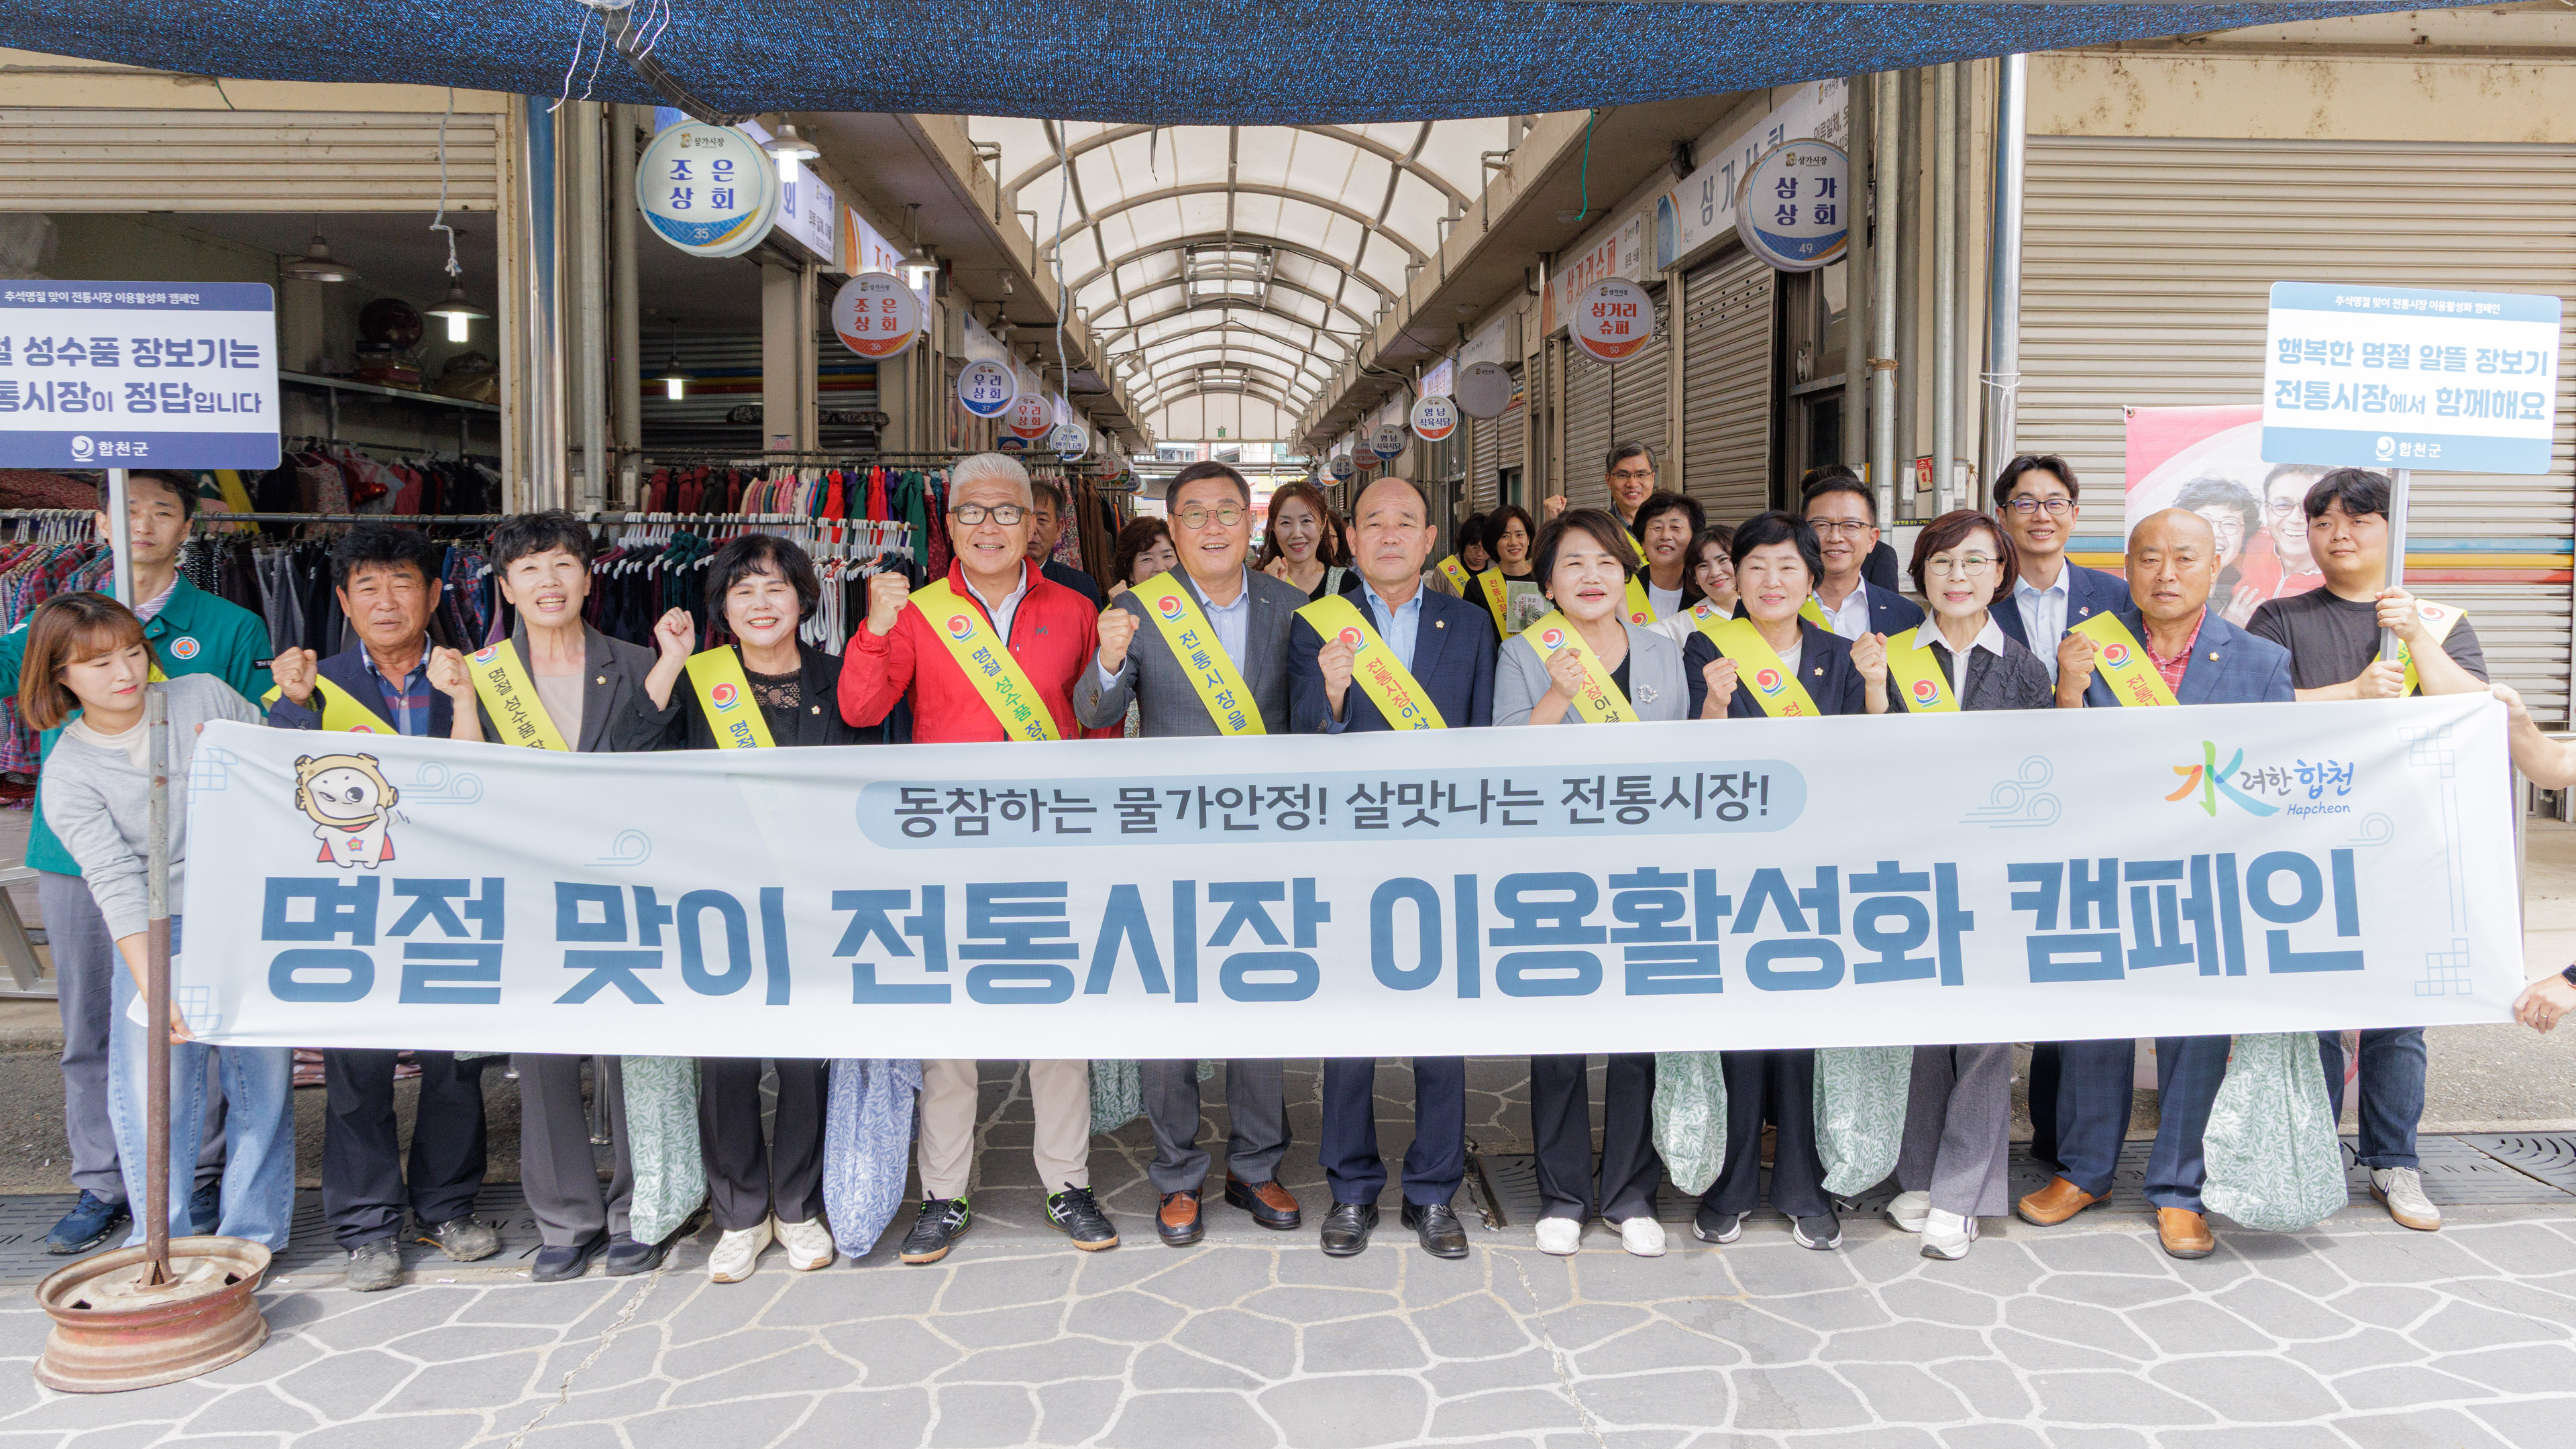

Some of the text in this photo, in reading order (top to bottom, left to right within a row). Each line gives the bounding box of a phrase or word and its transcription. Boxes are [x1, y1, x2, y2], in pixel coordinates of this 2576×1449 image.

[694, 137, 724, 146] 삼가시장
[1798, 156, 1827, 165] 삼가시장
[669, 159, 735, 182] 조은
[1774, 176, 1837, 199] 삼가
[669, 187, 734, 209] 상회
[1774, 204, 1837, 225] 상회
[694, 227, 709, 239] 35
[1799, 243, 1813, 254] 49
[5, 291, 200, 305] 추석명절 맞이 전통시장 이용활성화 캠페인
[853, 298, 898, 313] 조은
[2334, 295, 2500, 315] 추석명절 맞이 전통시장 이용활성화 캠페인
[1591, 303, 1638, 318] 삼거리
[854, 316, 898, 331] 상회
[1599, 321, 1630, 335] 슈퍼
[23, 336, 120, 367] 성수품
[131, 337, 260, 369] 장보기는
[871, 343, 881, 351] 36
[2278, 337, 2548, 376] 행복한 명절 알뜰 장보기
[973, 374, 1002, 386] 우리
[125, 382, 262, 413] 정답입니다
[973, 388, 1001, 399] 상회
[2275, 380, 2545, 420] 전통시장에서 함께해요
[1018, 405, 1041, 415] 우리
[1424, 408, 1446, 417] 영남
[1018, 417, 1040, 425] 상회
[1420, 417, 1450, 427] 식육식당
[98, 441, 149, 457] 합천군
[2399, 442, 2442, 458] 합천군
[972, 646, 1002, 678] 명절
[996, 676, 1032, 722] 성수품
[1179, 629, 1247, 731] 전통시장을
[1365, 657, 1420, 718] 전통시장이
[488, 667, 513, 696] 명절
[504, 698, 537, 739] 성수품
[2293, 759, 2354, 800] 합천
[894, 771, 1770, 838] 동참하는 물가안정! 살맛나는 전통시장!
[2287, 802, 2351, 820] Hapcheon
[261, 849, 2365, 1006] 명절 맞이 전통시장 이용활성화 캠페인
